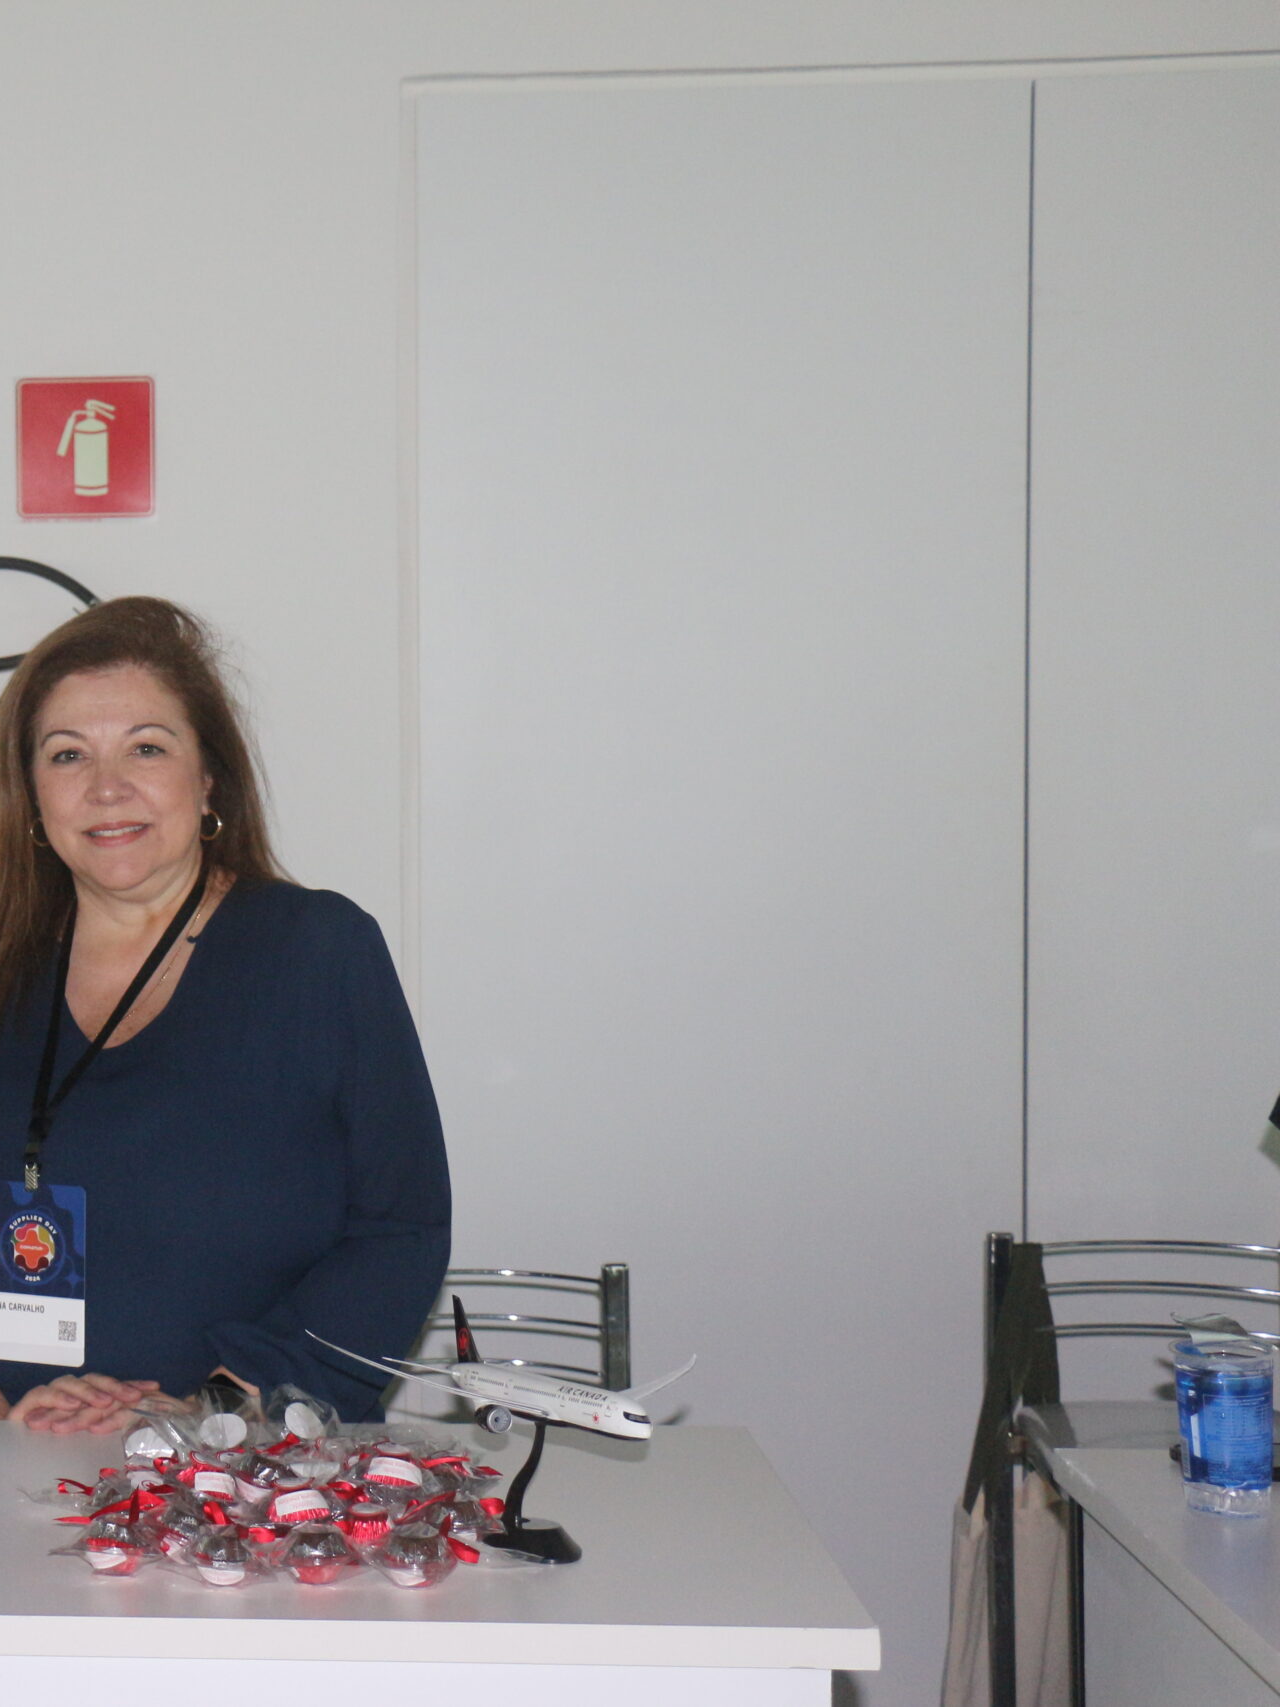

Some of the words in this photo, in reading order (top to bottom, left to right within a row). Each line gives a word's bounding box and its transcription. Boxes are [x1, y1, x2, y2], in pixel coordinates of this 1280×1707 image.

[9, 1214, 43, 1230] SUPPLIER
[44, 1221, 57, 1234] DAY
[8, 1302, 45, 1313] CARVALHO
[558, 1385, 574, 1395] AIR
[573, 1387, 609, 1401] CANADA
